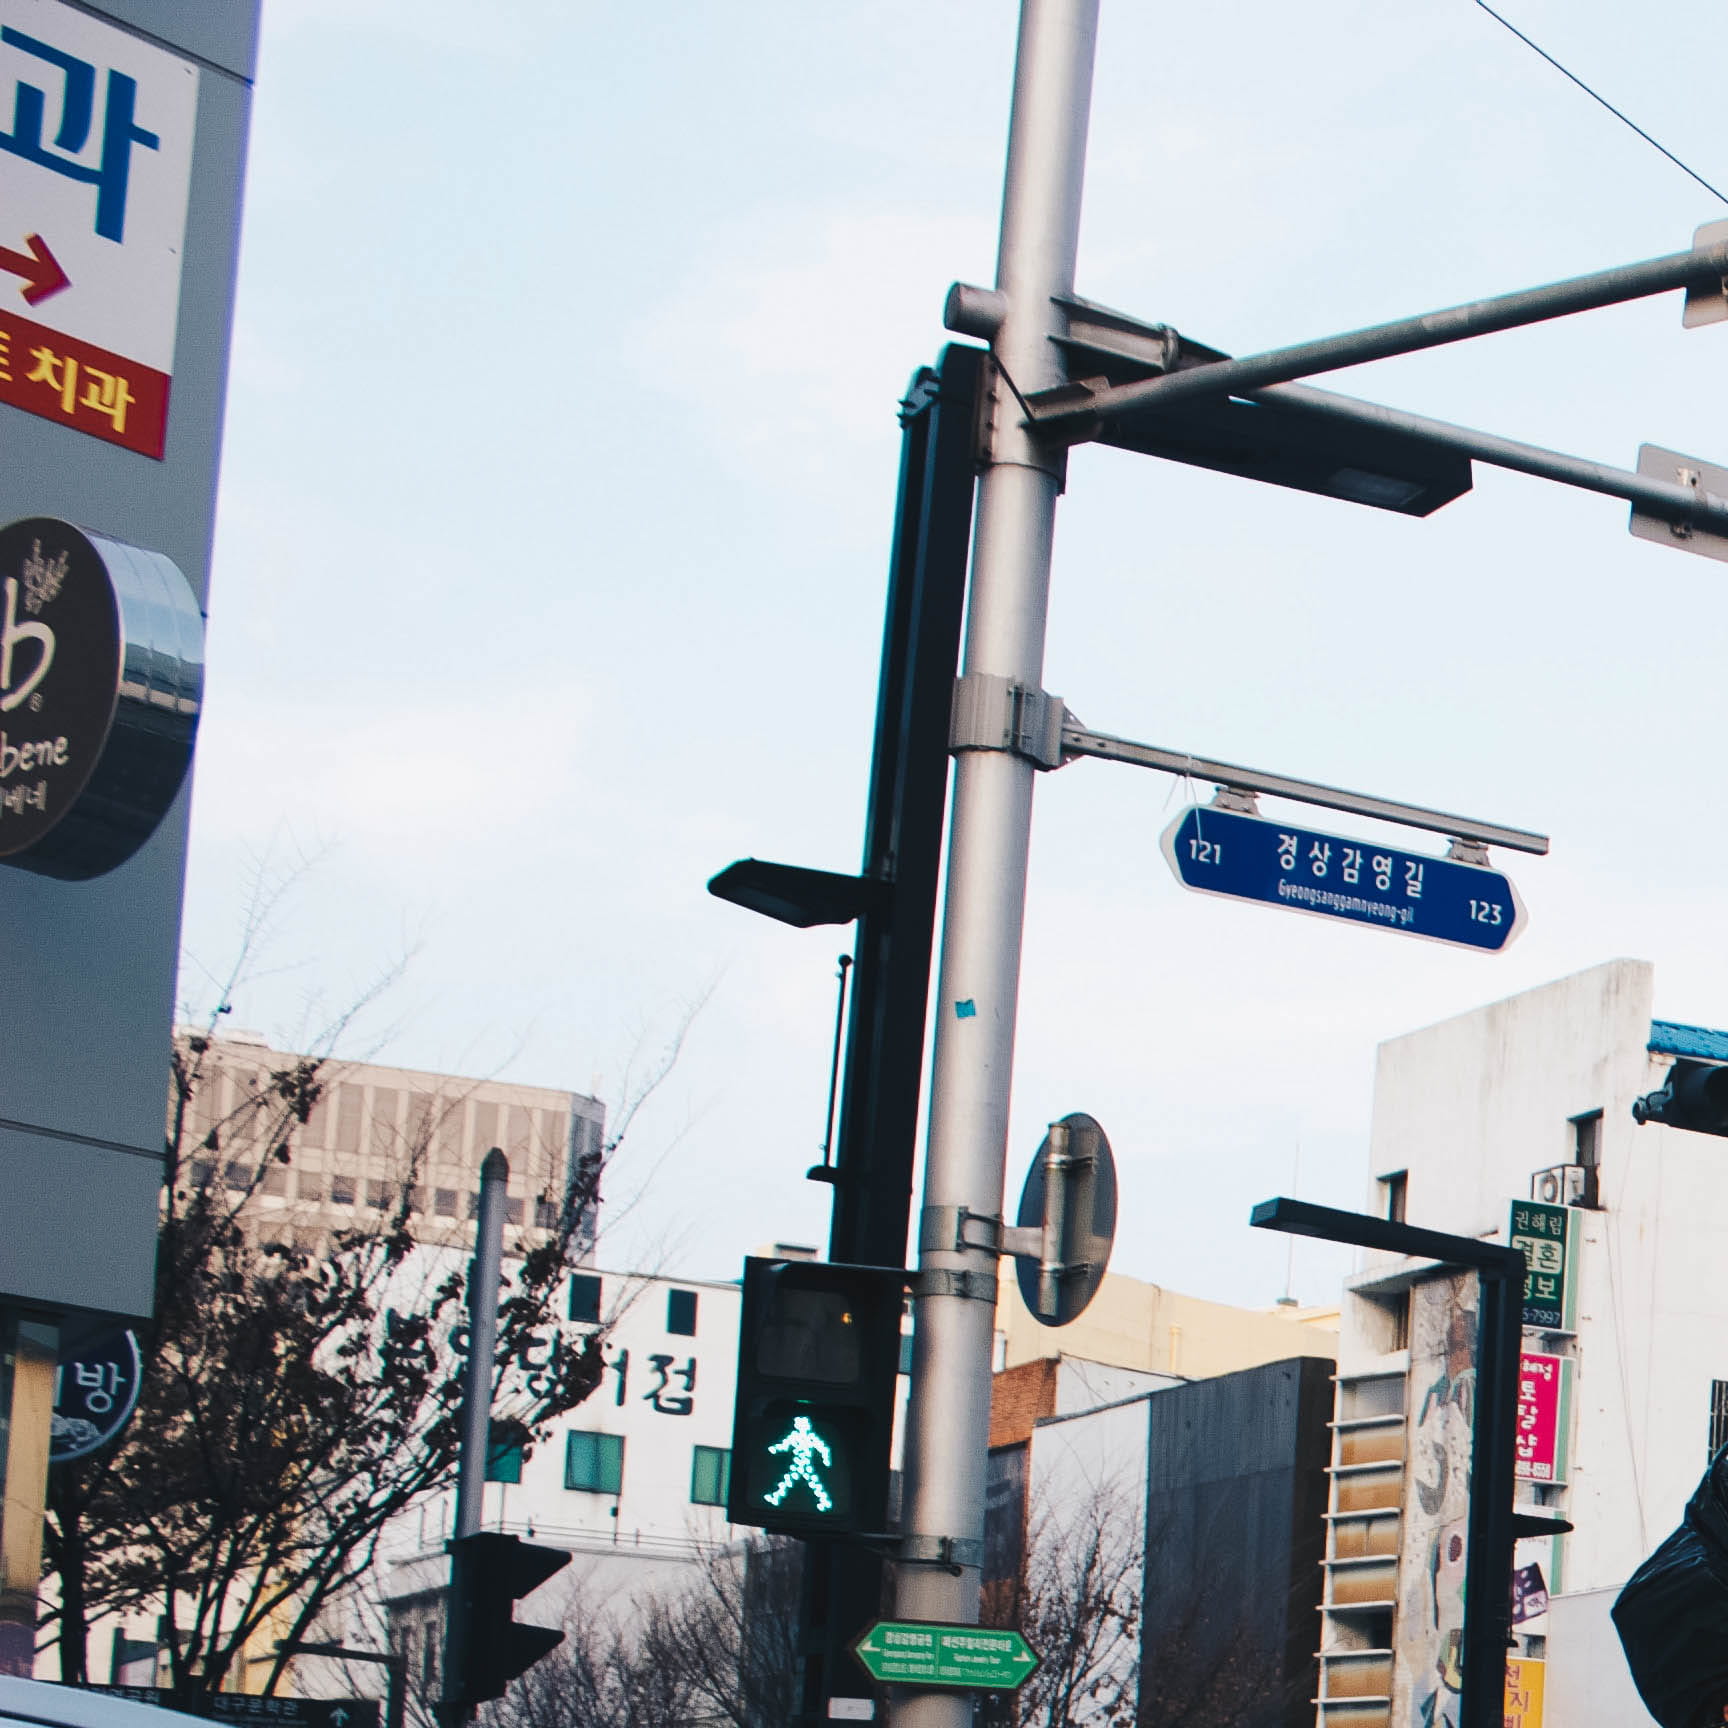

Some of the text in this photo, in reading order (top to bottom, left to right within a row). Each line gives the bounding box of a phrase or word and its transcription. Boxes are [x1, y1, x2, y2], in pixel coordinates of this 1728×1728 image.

[0, 24, 159, 244] 과
[28, 345, 136, 434] 치과
[1188, 839, 1222, 865] 121
[1277, 833, 1424, 898] 경상감영길
[1468, 899, 1503, 925] 123
